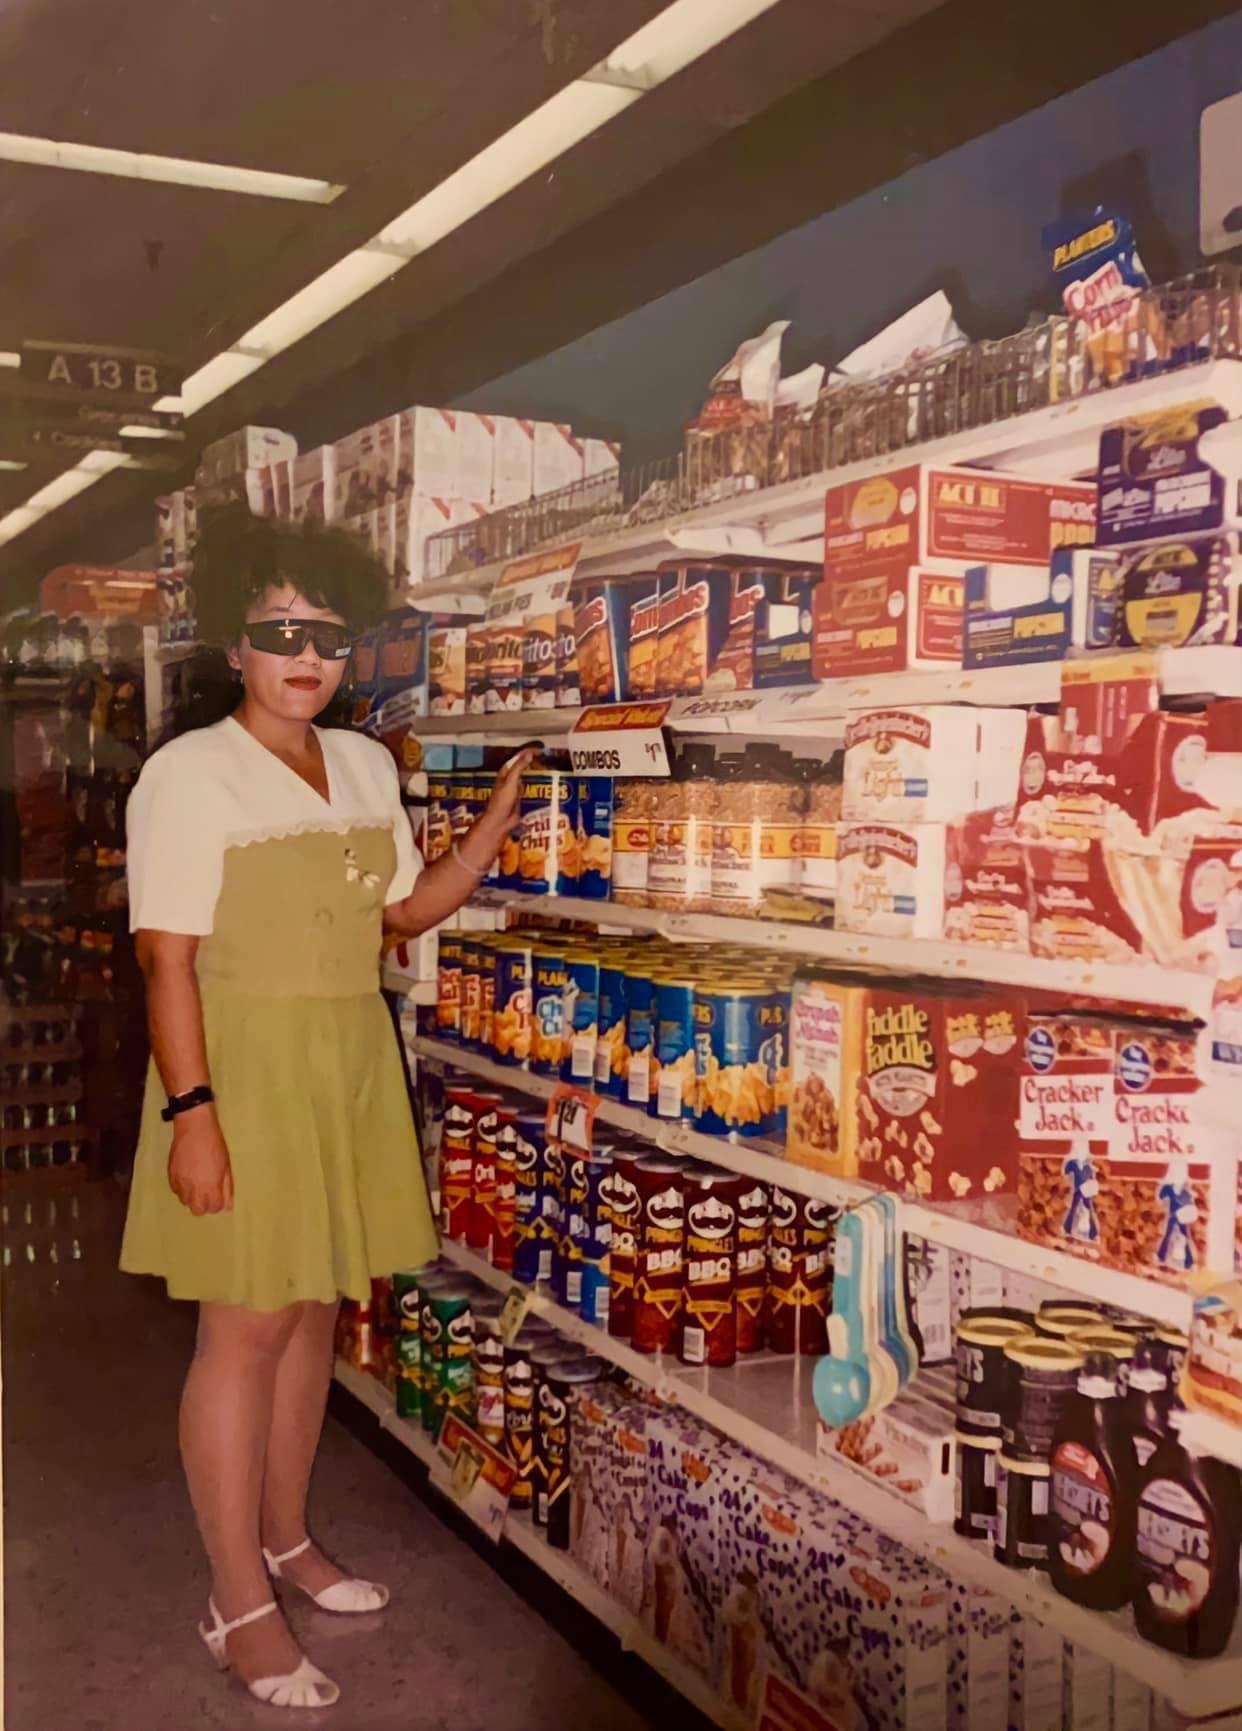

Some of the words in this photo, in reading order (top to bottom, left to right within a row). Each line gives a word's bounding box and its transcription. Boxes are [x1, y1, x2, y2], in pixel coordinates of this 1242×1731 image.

[48, 354, 72, 384] A
[88, 360, 122, 390] 13
[135, 364, 158, 393] B
[573, 750, 621, 770] COMBOS
[1024, 1078, 1105, 1104] Cracker
[820, 1578, 863, 1613] Cake
